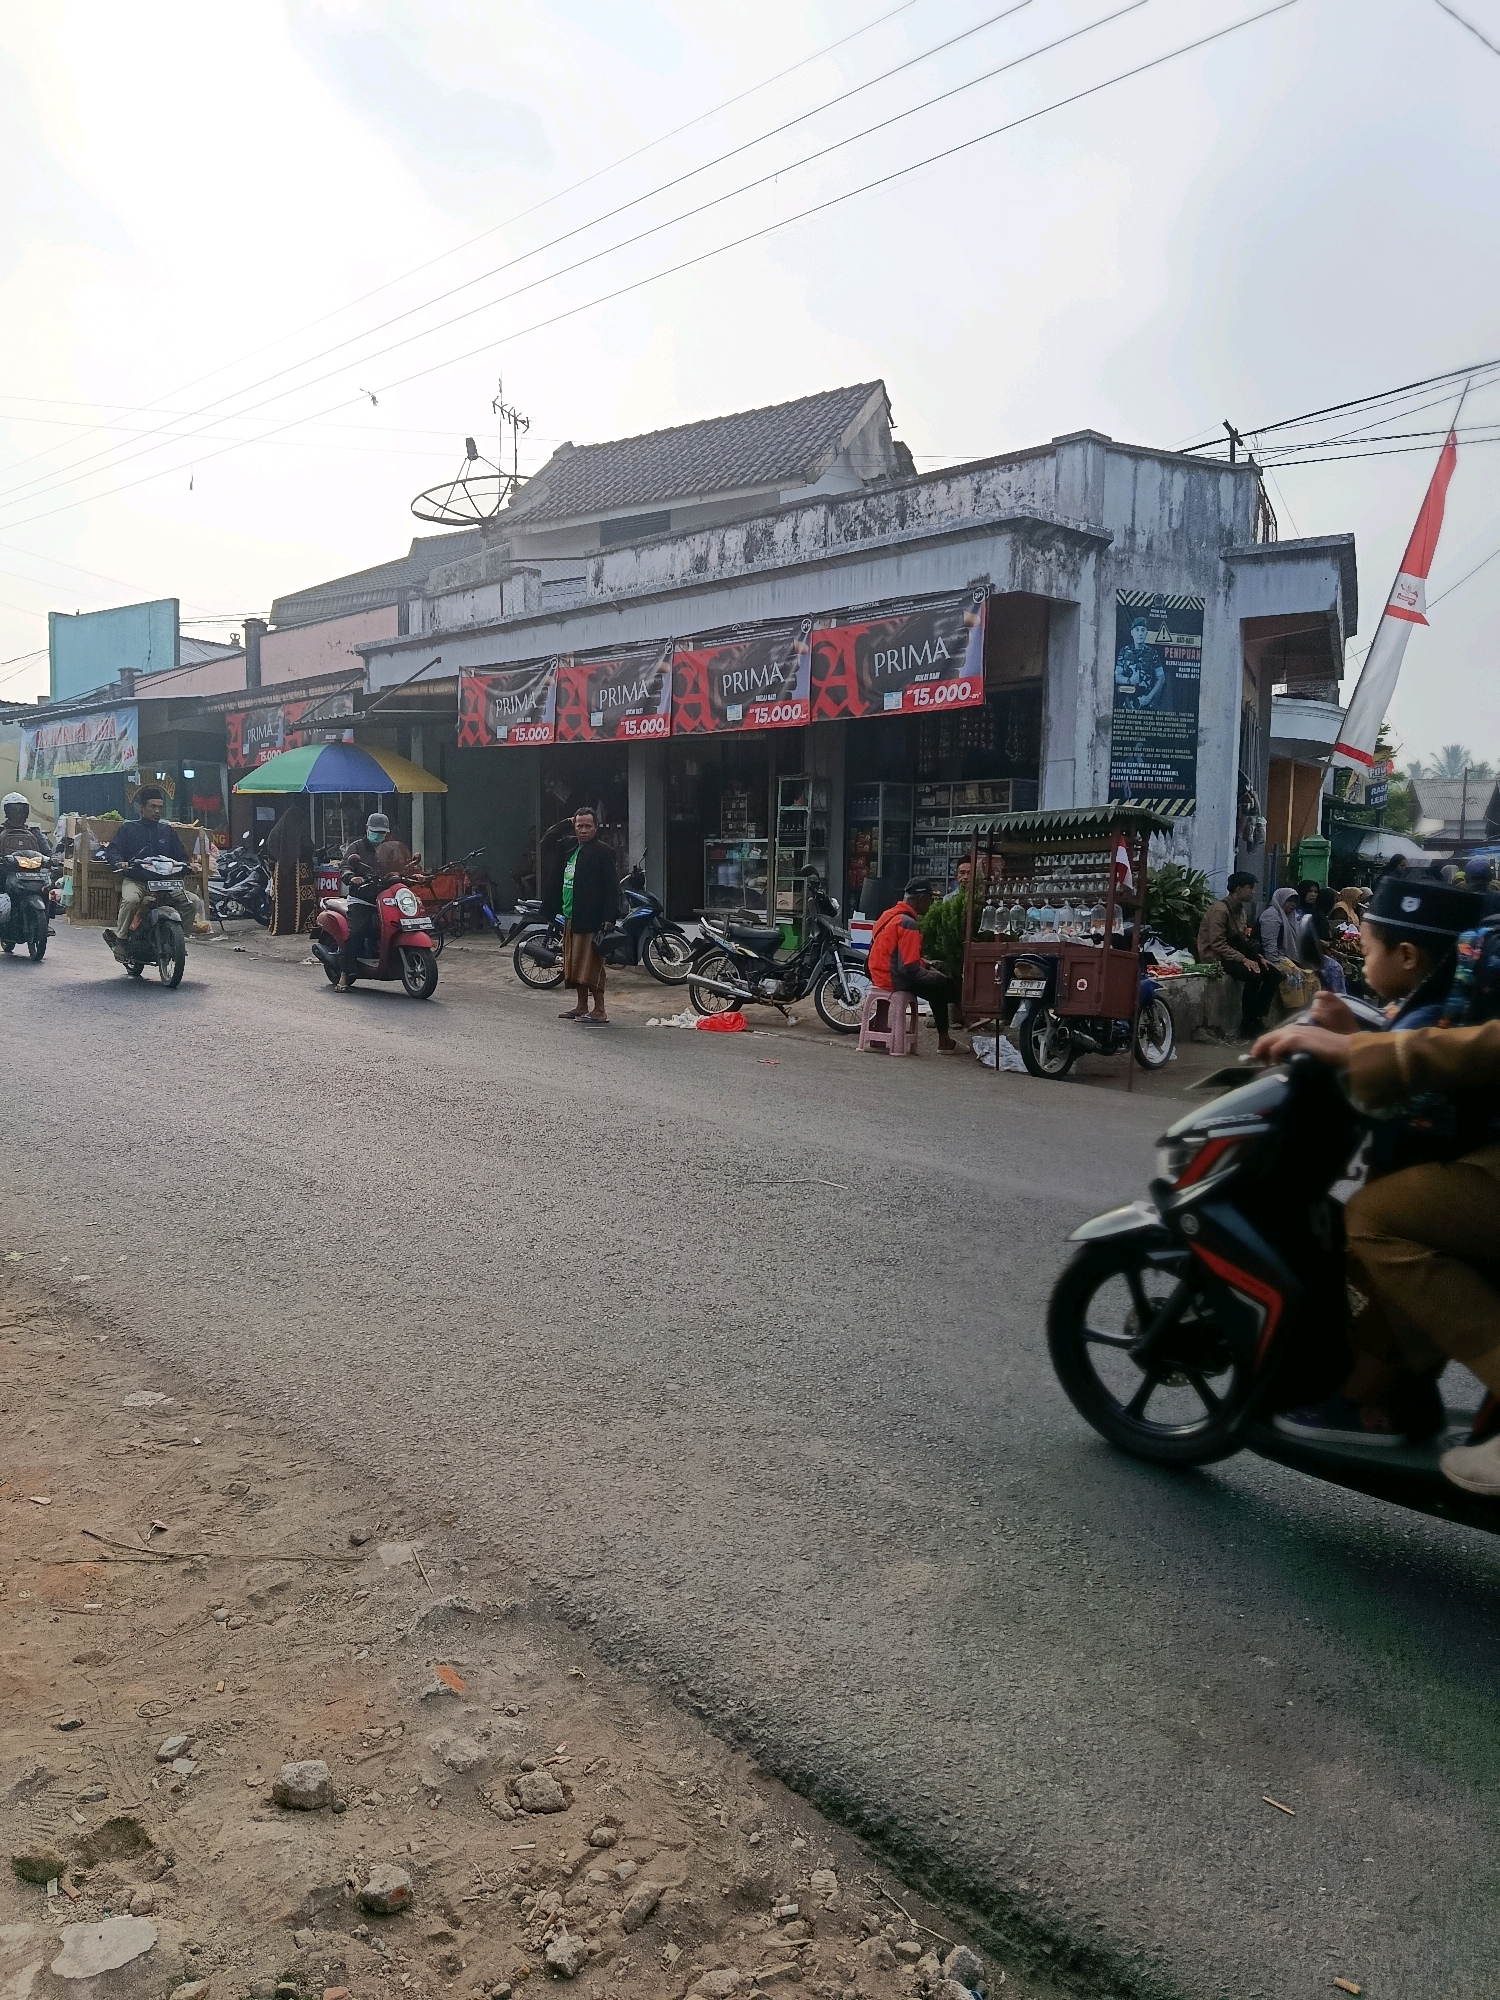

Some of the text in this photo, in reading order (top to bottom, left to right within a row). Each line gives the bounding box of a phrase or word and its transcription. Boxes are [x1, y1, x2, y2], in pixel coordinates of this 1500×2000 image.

[874, 636, 951, 677] PRIMA
[599, 678, 650, 710] PRIMA
[722, 661, 785, 697] PRIMA
[495, 691, 537, 718] PRIMA
[247, 722, 274, 745] PRIMA
